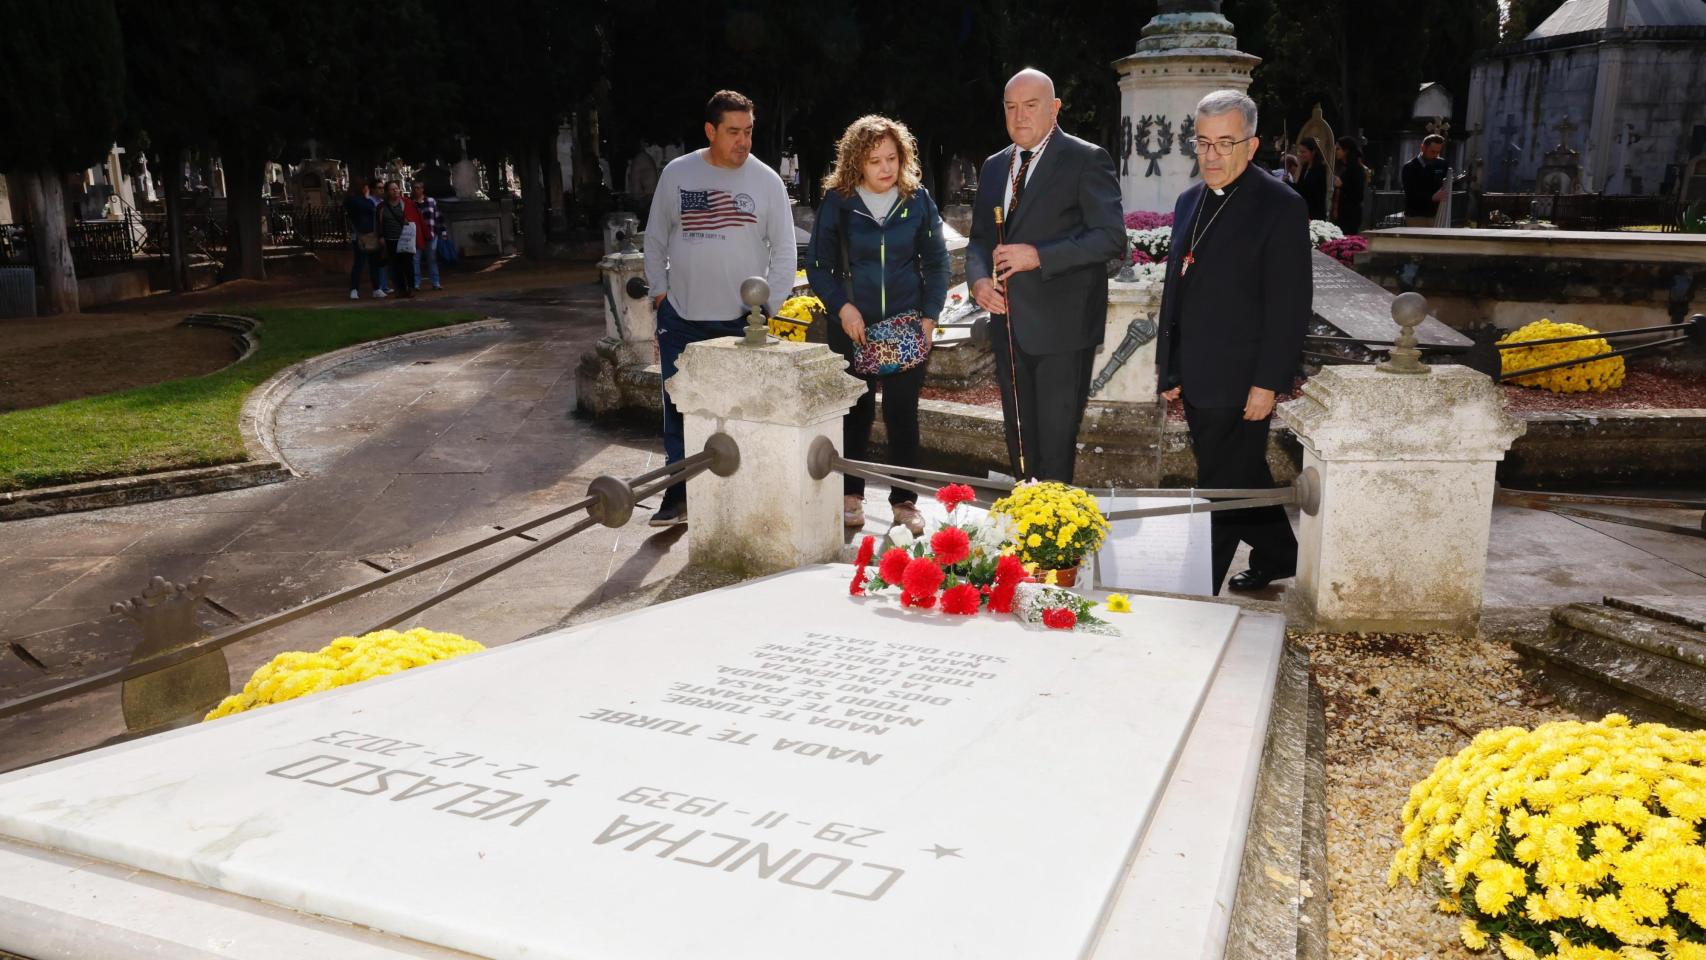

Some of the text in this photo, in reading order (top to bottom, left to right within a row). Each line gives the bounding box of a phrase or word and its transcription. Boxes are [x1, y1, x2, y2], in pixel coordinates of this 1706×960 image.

[757, 643, 821, 656] TIENE
[883, 643, 940, 654] DIOS
[829, 653, 889, 665] DIOS
[918, 655, 981, 668] NADA
[761, 662, 933, 691] LA PACIENCIA
[867, 667, 902, 676] LO
[920, 665, 997, 679] QUIEN
[793, 677, 831, 688] SE
[907, 673, 976, 687] TODO
[791, 689, 831, 700] SE
[836, 684, 877, 694] NO
[836, 696, 910, 712] TODO
[883, 690, 952, 706] DIOS
[797, 702, 832, 713] TE
[760, 709, 796, 722] TE
[845, 708, 924, 726] NADA
[808, 715, 890, 735] NADA
[578, 708, 884, 766] NADA TE TURBE
[265, 755, 905, 901] CONCHA VELASCO
